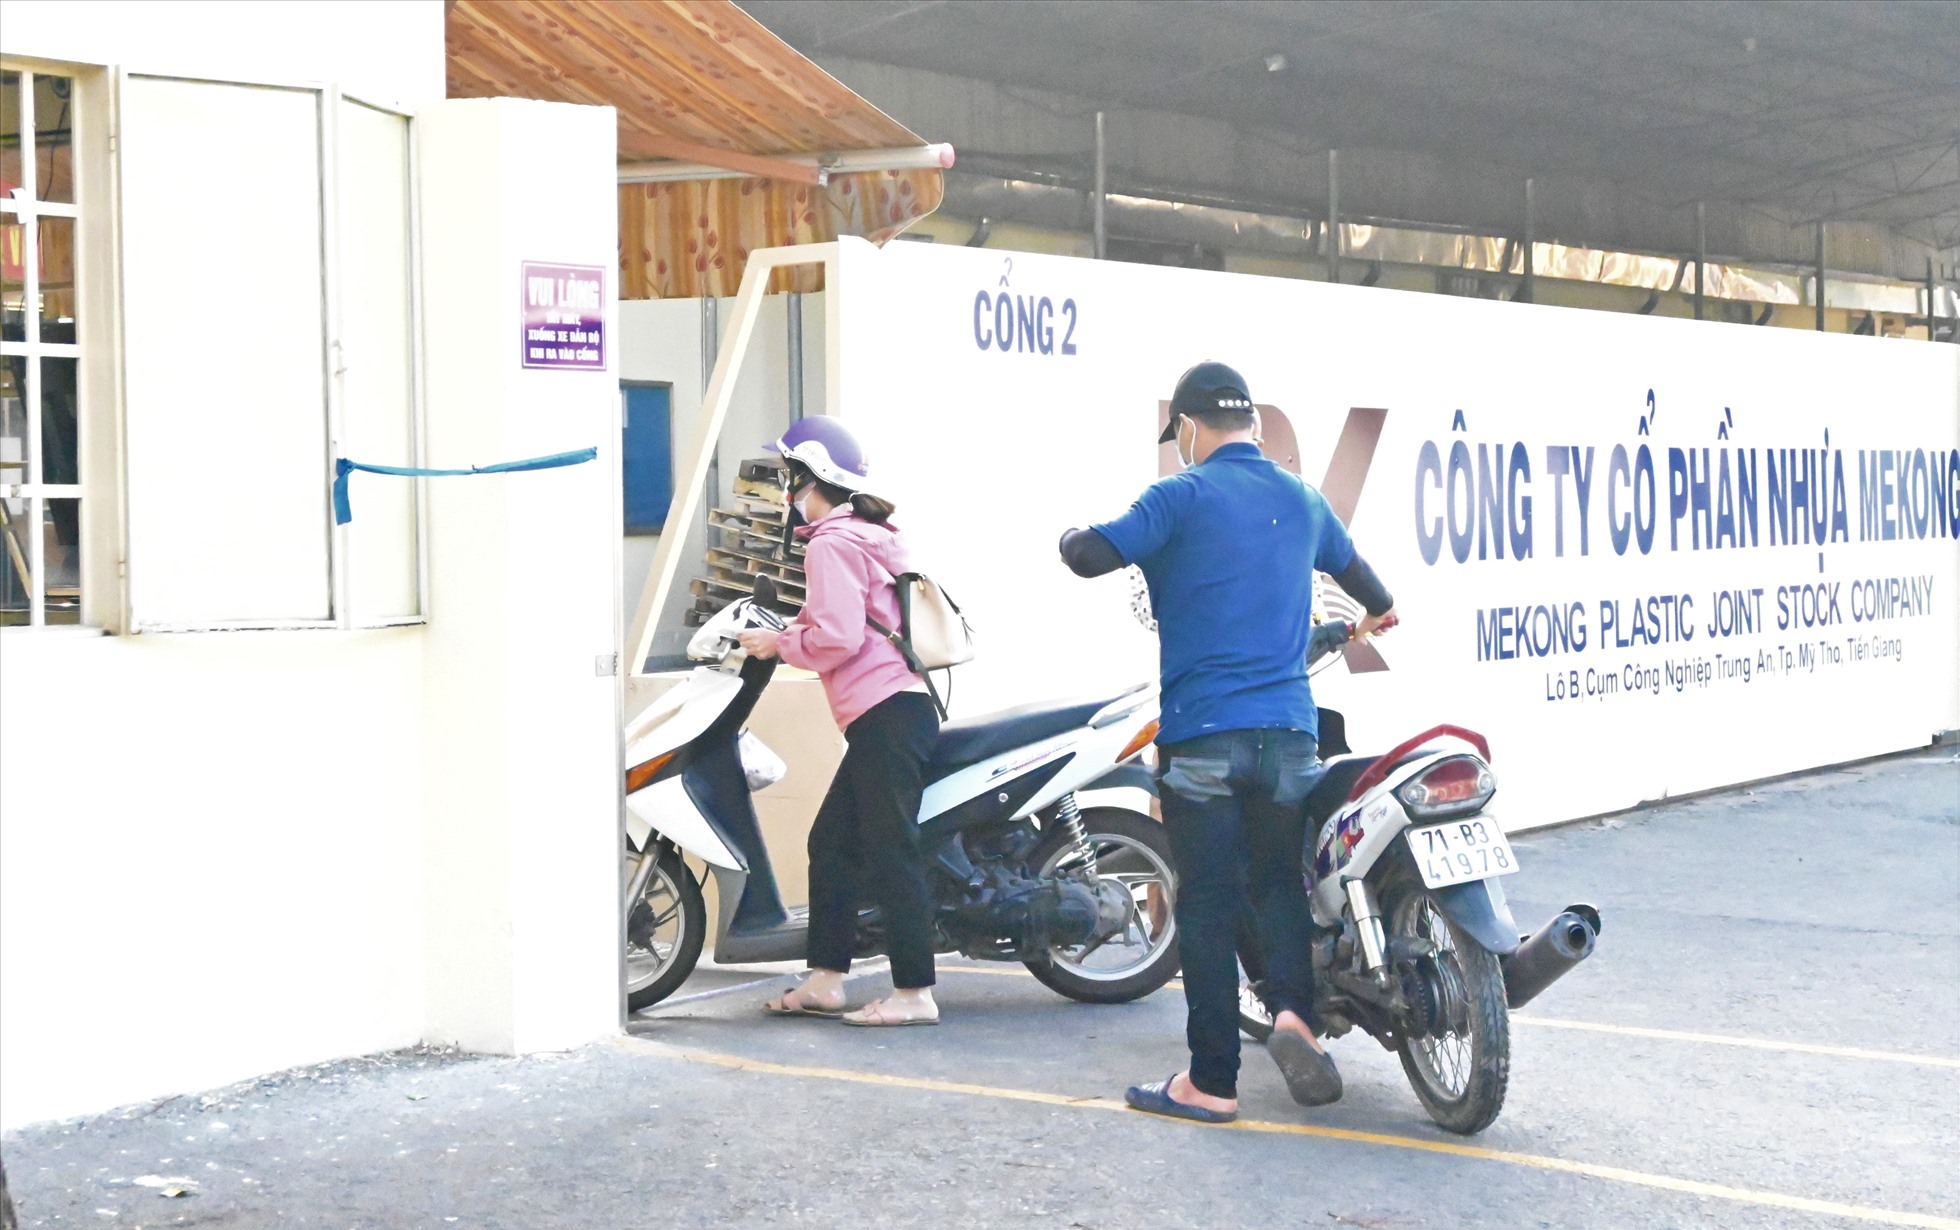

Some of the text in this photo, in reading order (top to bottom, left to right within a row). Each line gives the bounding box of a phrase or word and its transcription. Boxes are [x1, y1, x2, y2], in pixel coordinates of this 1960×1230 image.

[528, 276, 554, 306] VUI
[974, 257, 1077, 356] CỔNG 2
[557, 330, 568, 342] XE
[1415, 388, 1960, 573] CÔNG TY CỔ PHẦN NHỰA MEKONG
[1477, 575, 1933, 662] MEKONG PLASTIC JOINT STOCK COMPANY
[1546, 672, 1566, 701] Lô
[1623, 663, 1660, 695] Công
[1665, 656, 1712, 692] Nghiệp
[1716, 653, 1750, 683] Trung
[1756, 648, 1776, 676] An,
[1778, 645, 1796, 676] Tp.
[1799, 642, 1816, 673] Mỹ
[1819, 640, 1844, 668] Tho,
[1872, 635, 1903, 662] Giang
[1422, 821, 1490, 854] 71-B3
